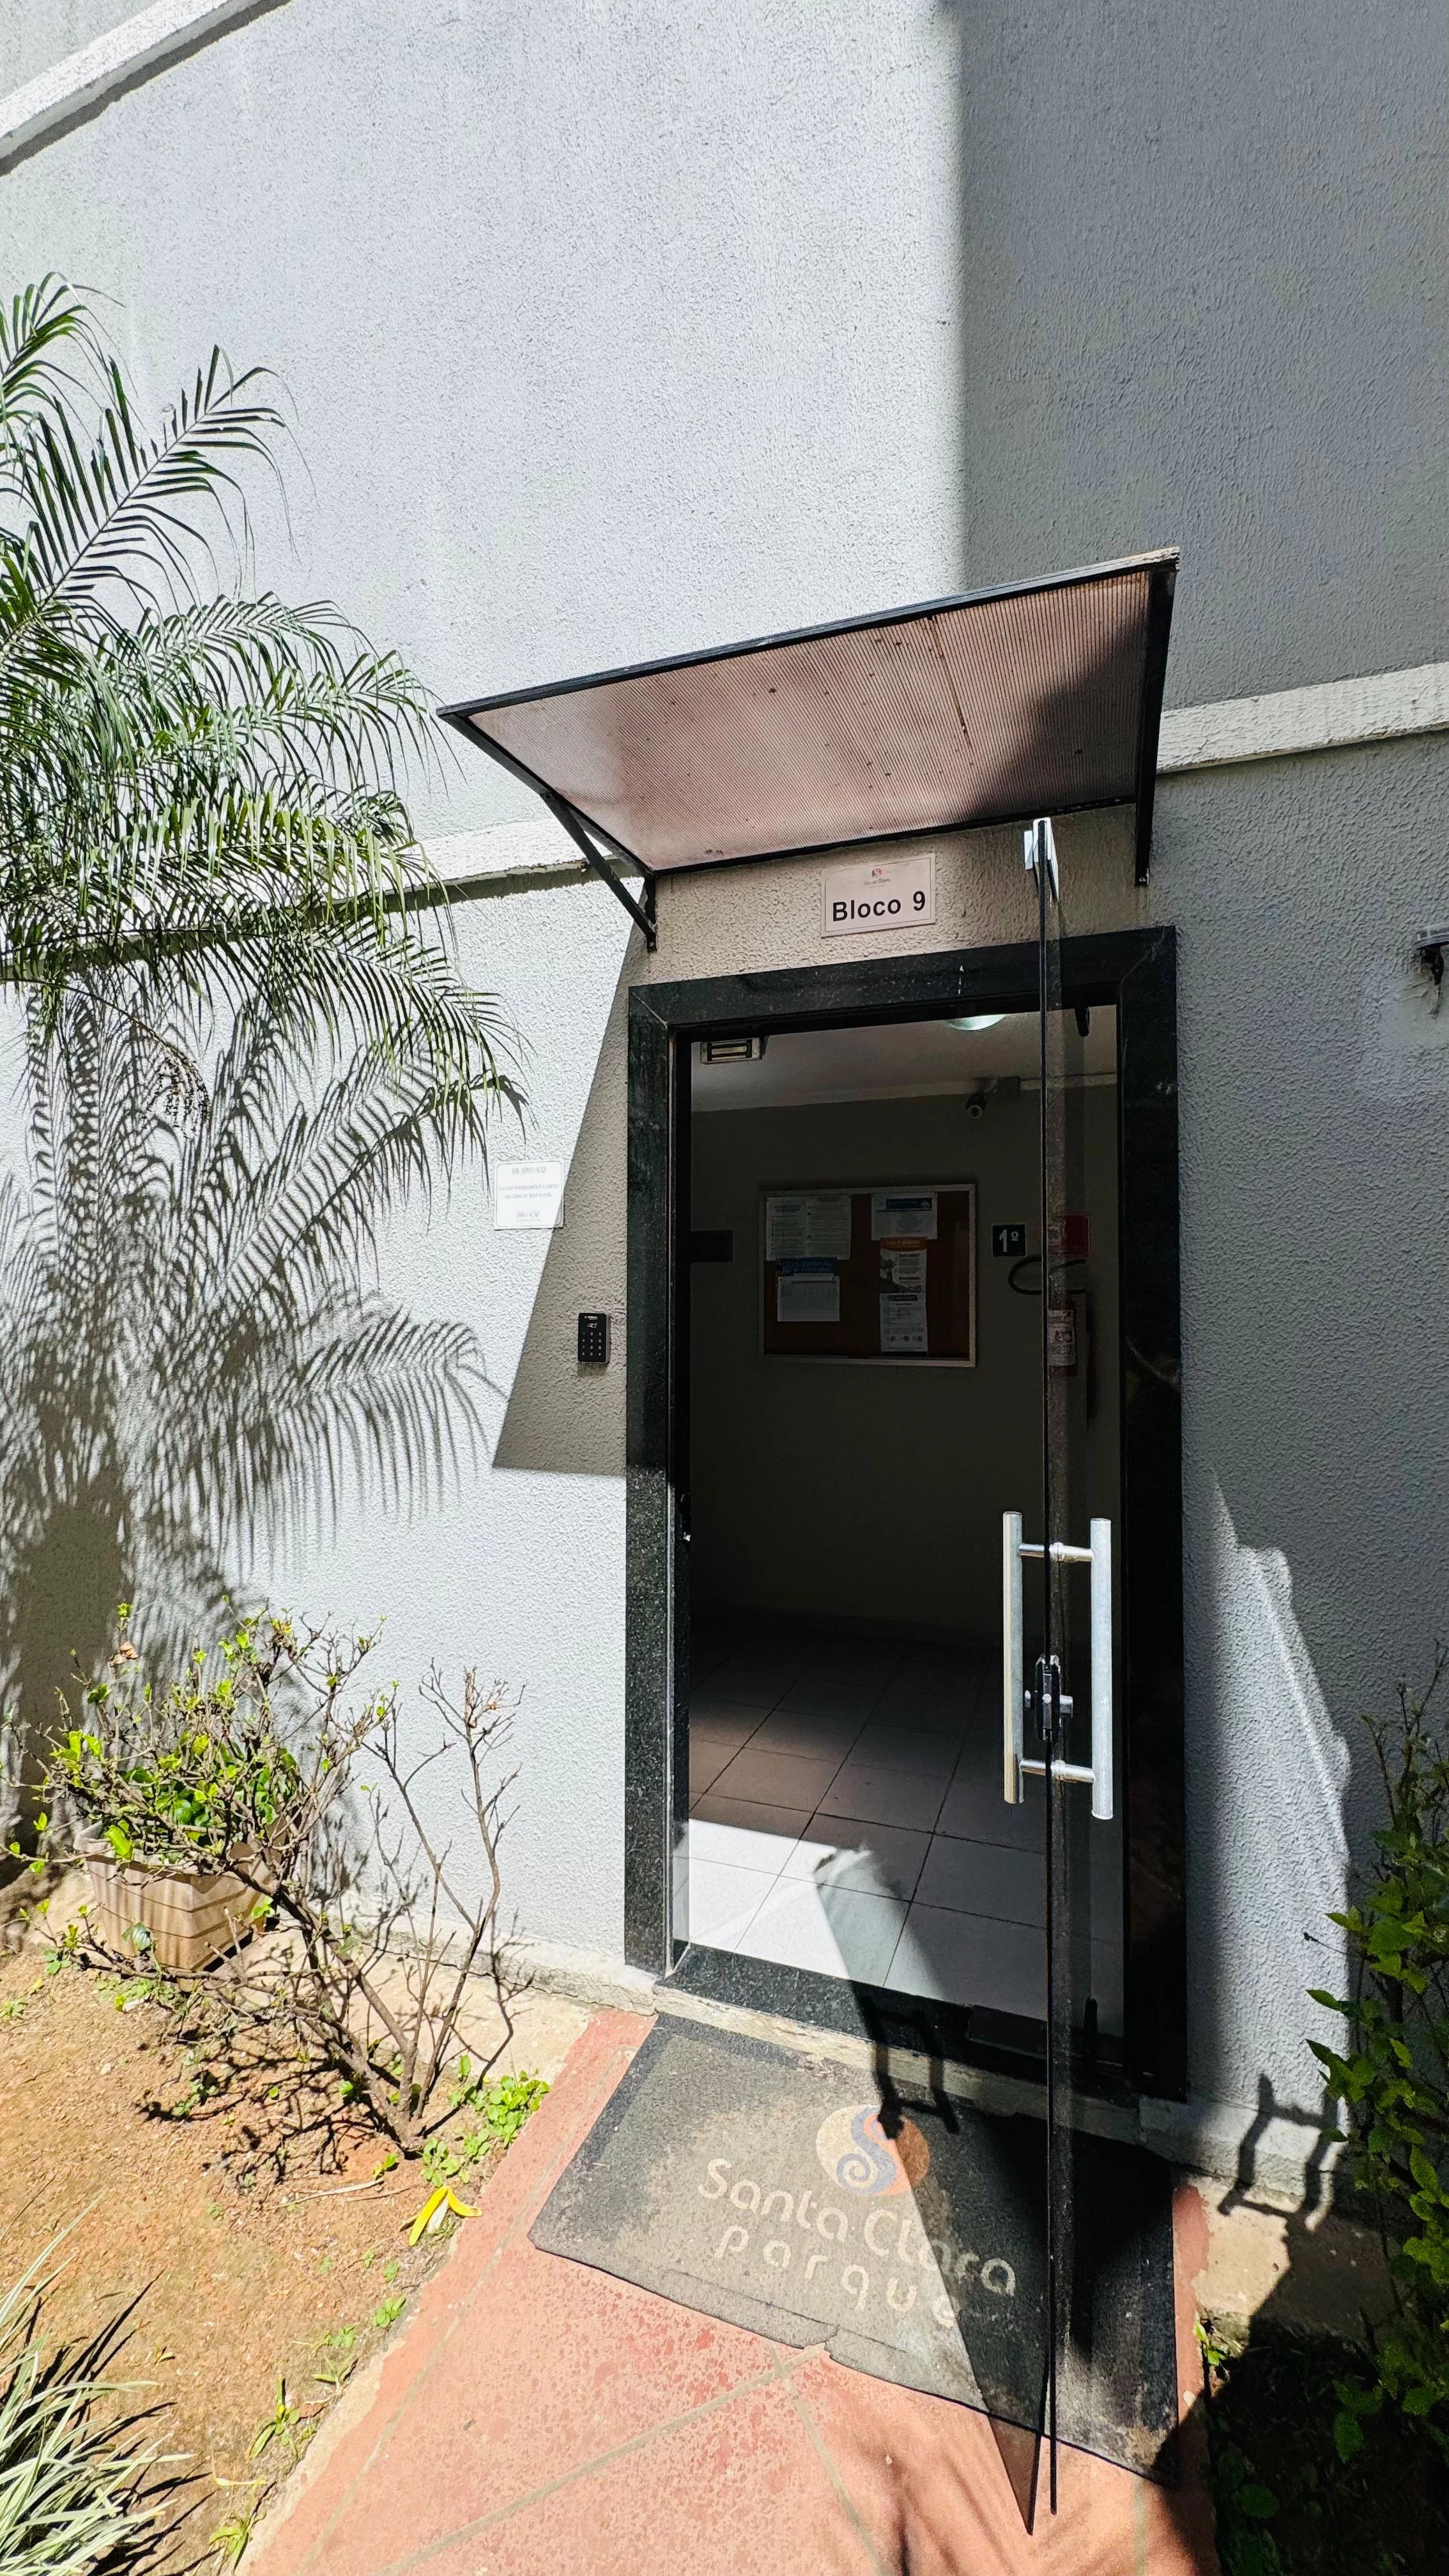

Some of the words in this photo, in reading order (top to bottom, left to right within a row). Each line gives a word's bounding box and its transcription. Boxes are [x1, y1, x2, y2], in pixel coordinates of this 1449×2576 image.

[832, 900, 901, 922] Bloco
[913, 891, 925, 911] 9
[698, 2158, 848, 2242] Santa
[864, 2209, 1016, 2296] Clara
[714, 2225, 960, 2328] parque
